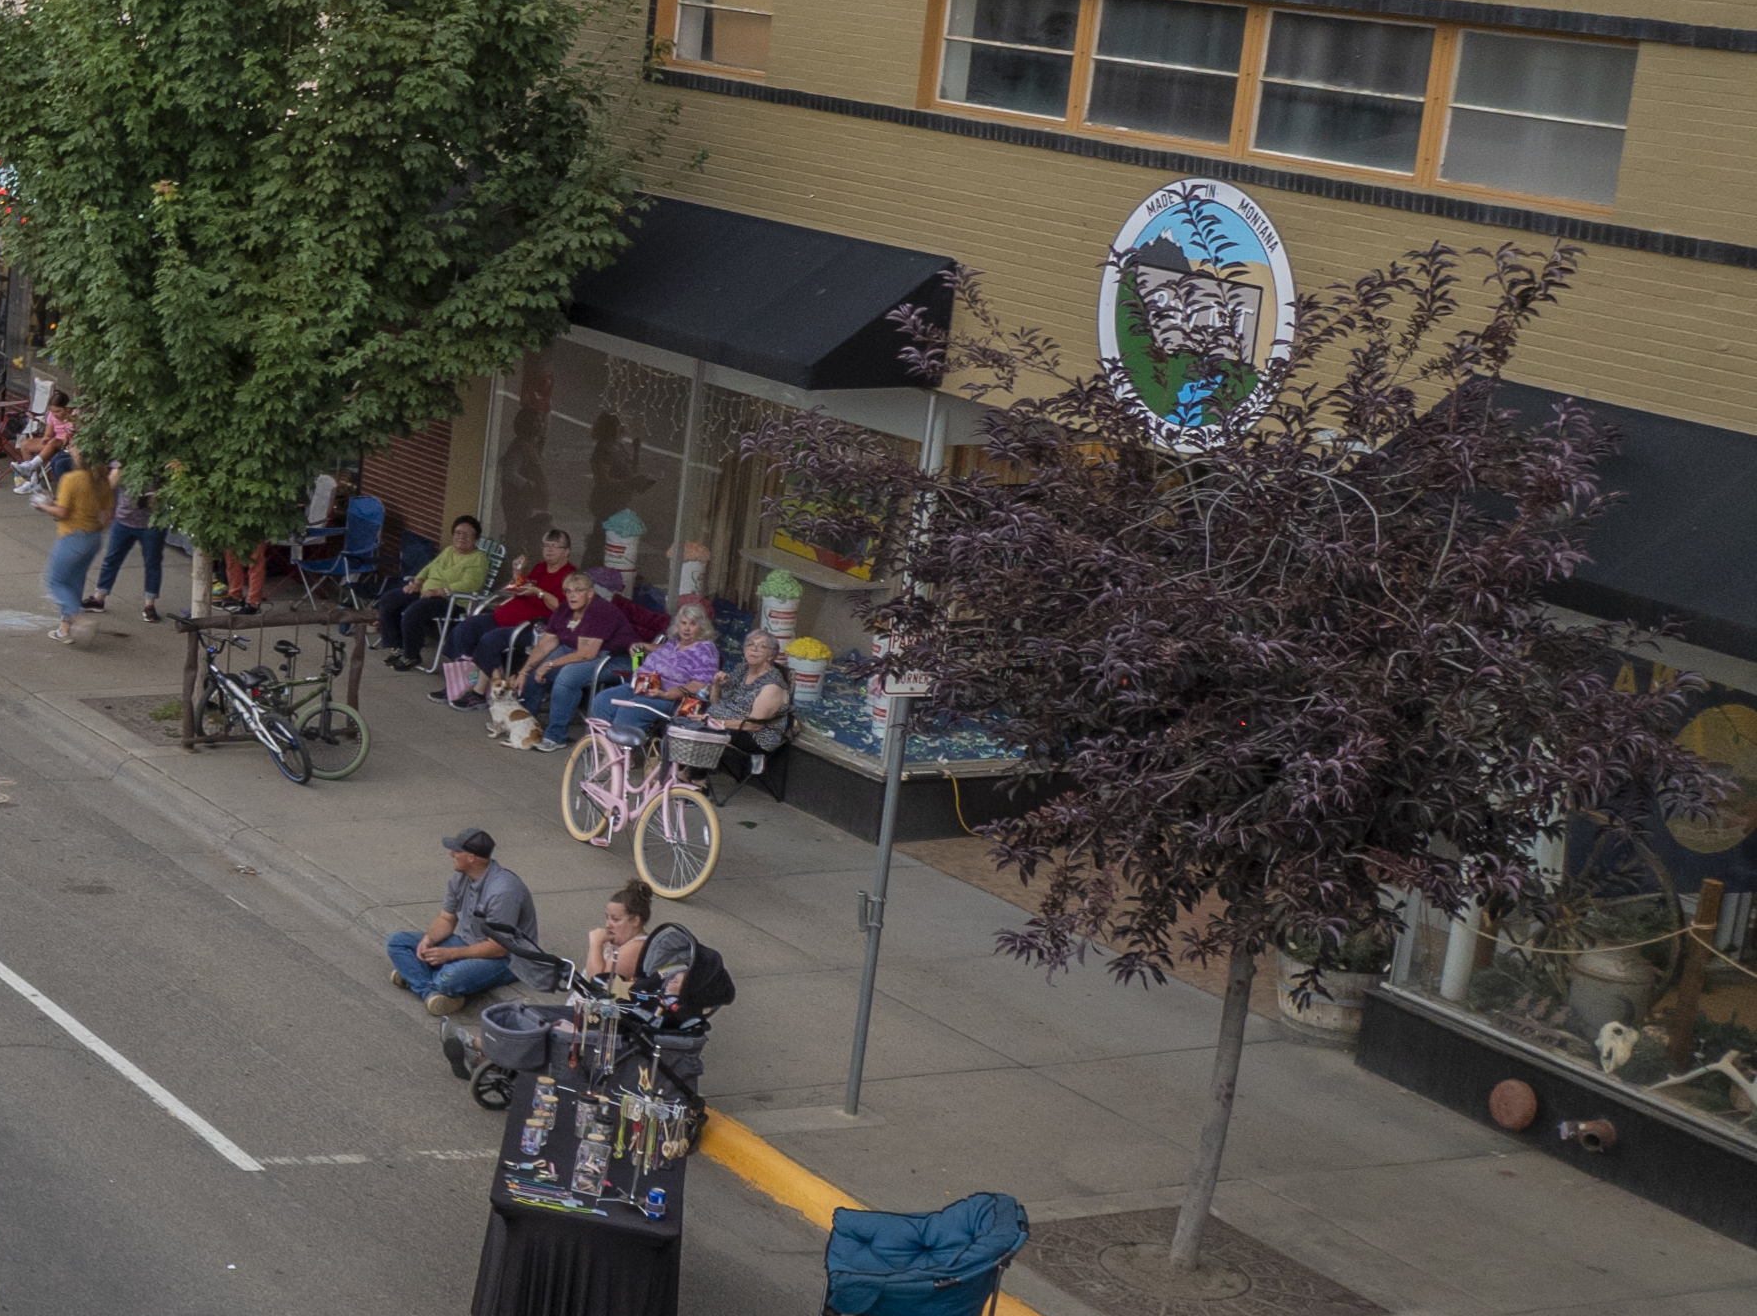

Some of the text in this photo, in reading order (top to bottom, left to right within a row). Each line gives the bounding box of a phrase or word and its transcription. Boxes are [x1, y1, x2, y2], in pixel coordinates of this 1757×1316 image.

[1145, 184, 1279, 254] MADE IN MONTANA
